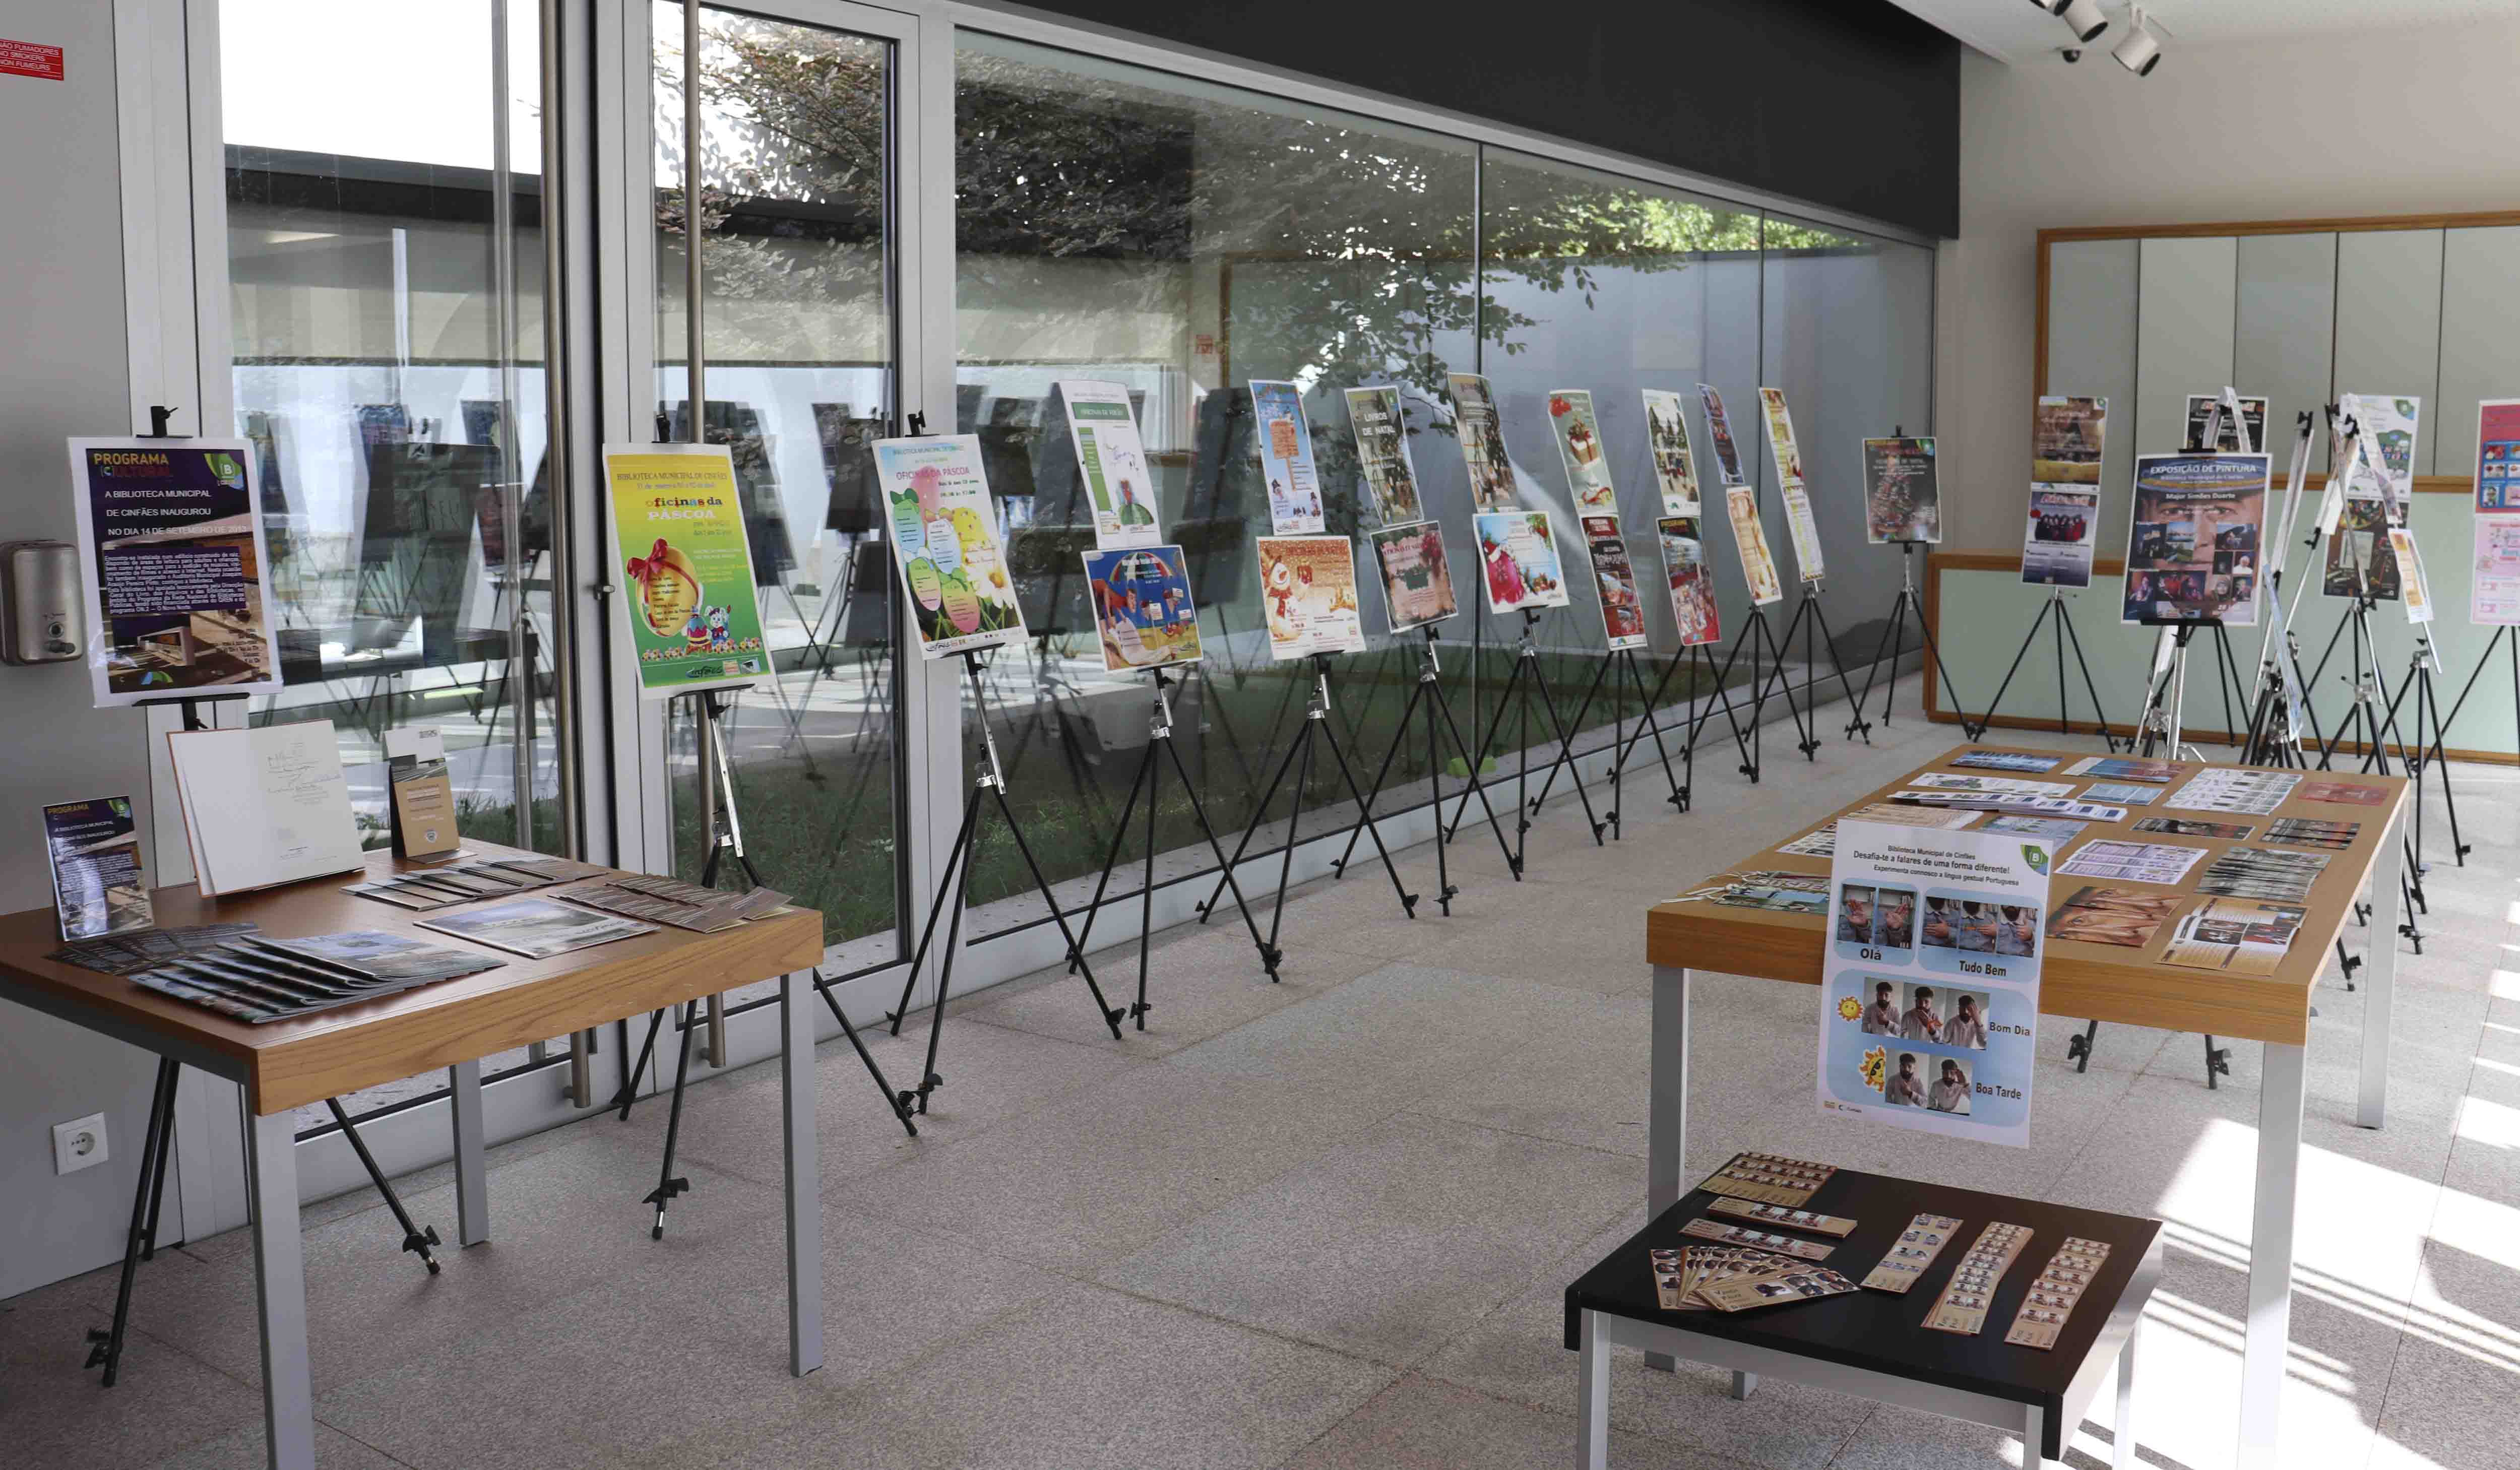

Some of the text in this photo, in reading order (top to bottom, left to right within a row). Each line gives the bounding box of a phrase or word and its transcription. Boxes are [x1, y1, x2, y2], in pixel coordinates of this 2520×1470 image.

[1364, 412, 1388, 422] LIVROS
[1362, 424, 1396, 436] DE NATAL
[94, 453, 169, 465] PROGRAMA
[943, 466, 970, 476] PÁSCOA
[2151, 464, 2257, 474] EXPOSIÇÃO DE PINTURA
[616, 472, 659, 480] BIBLIOTECA
[646, 496, 722, 507] oficinas da
[121, 507, 158, 516] CINFÃES
[647, 507, 716, 520] PÁSCOA
[1887, 845, 1915, 853] Biblioteca
[1917, 848, 1944, 857] Municipal
[1954, 852, 1976, 860] Cinfães
[1853, 851, 1888, 862] Desafia-te
[1897, 855, 1921, 865] falares
[1923, 858, 1932, 866] de
[1951, 861, 1973, 871] forma
[1975, 863, 2010, 875] diferente!
[1874, 865, 1909, 875] Experimenta
[1910, 869, 1937, 877] connosco
[1963, 874, 1984, 883] gestual
[1985, 876, 2019, 887] Portuguesa
[1860, 948, 1882, 961] Olá
[1959, 960, 2007, 977] Tudo Bem
[1989, 1021, 2031, 1037] Bom Dia
[1975, 1082, 2022, 1100] Boa Tarde
